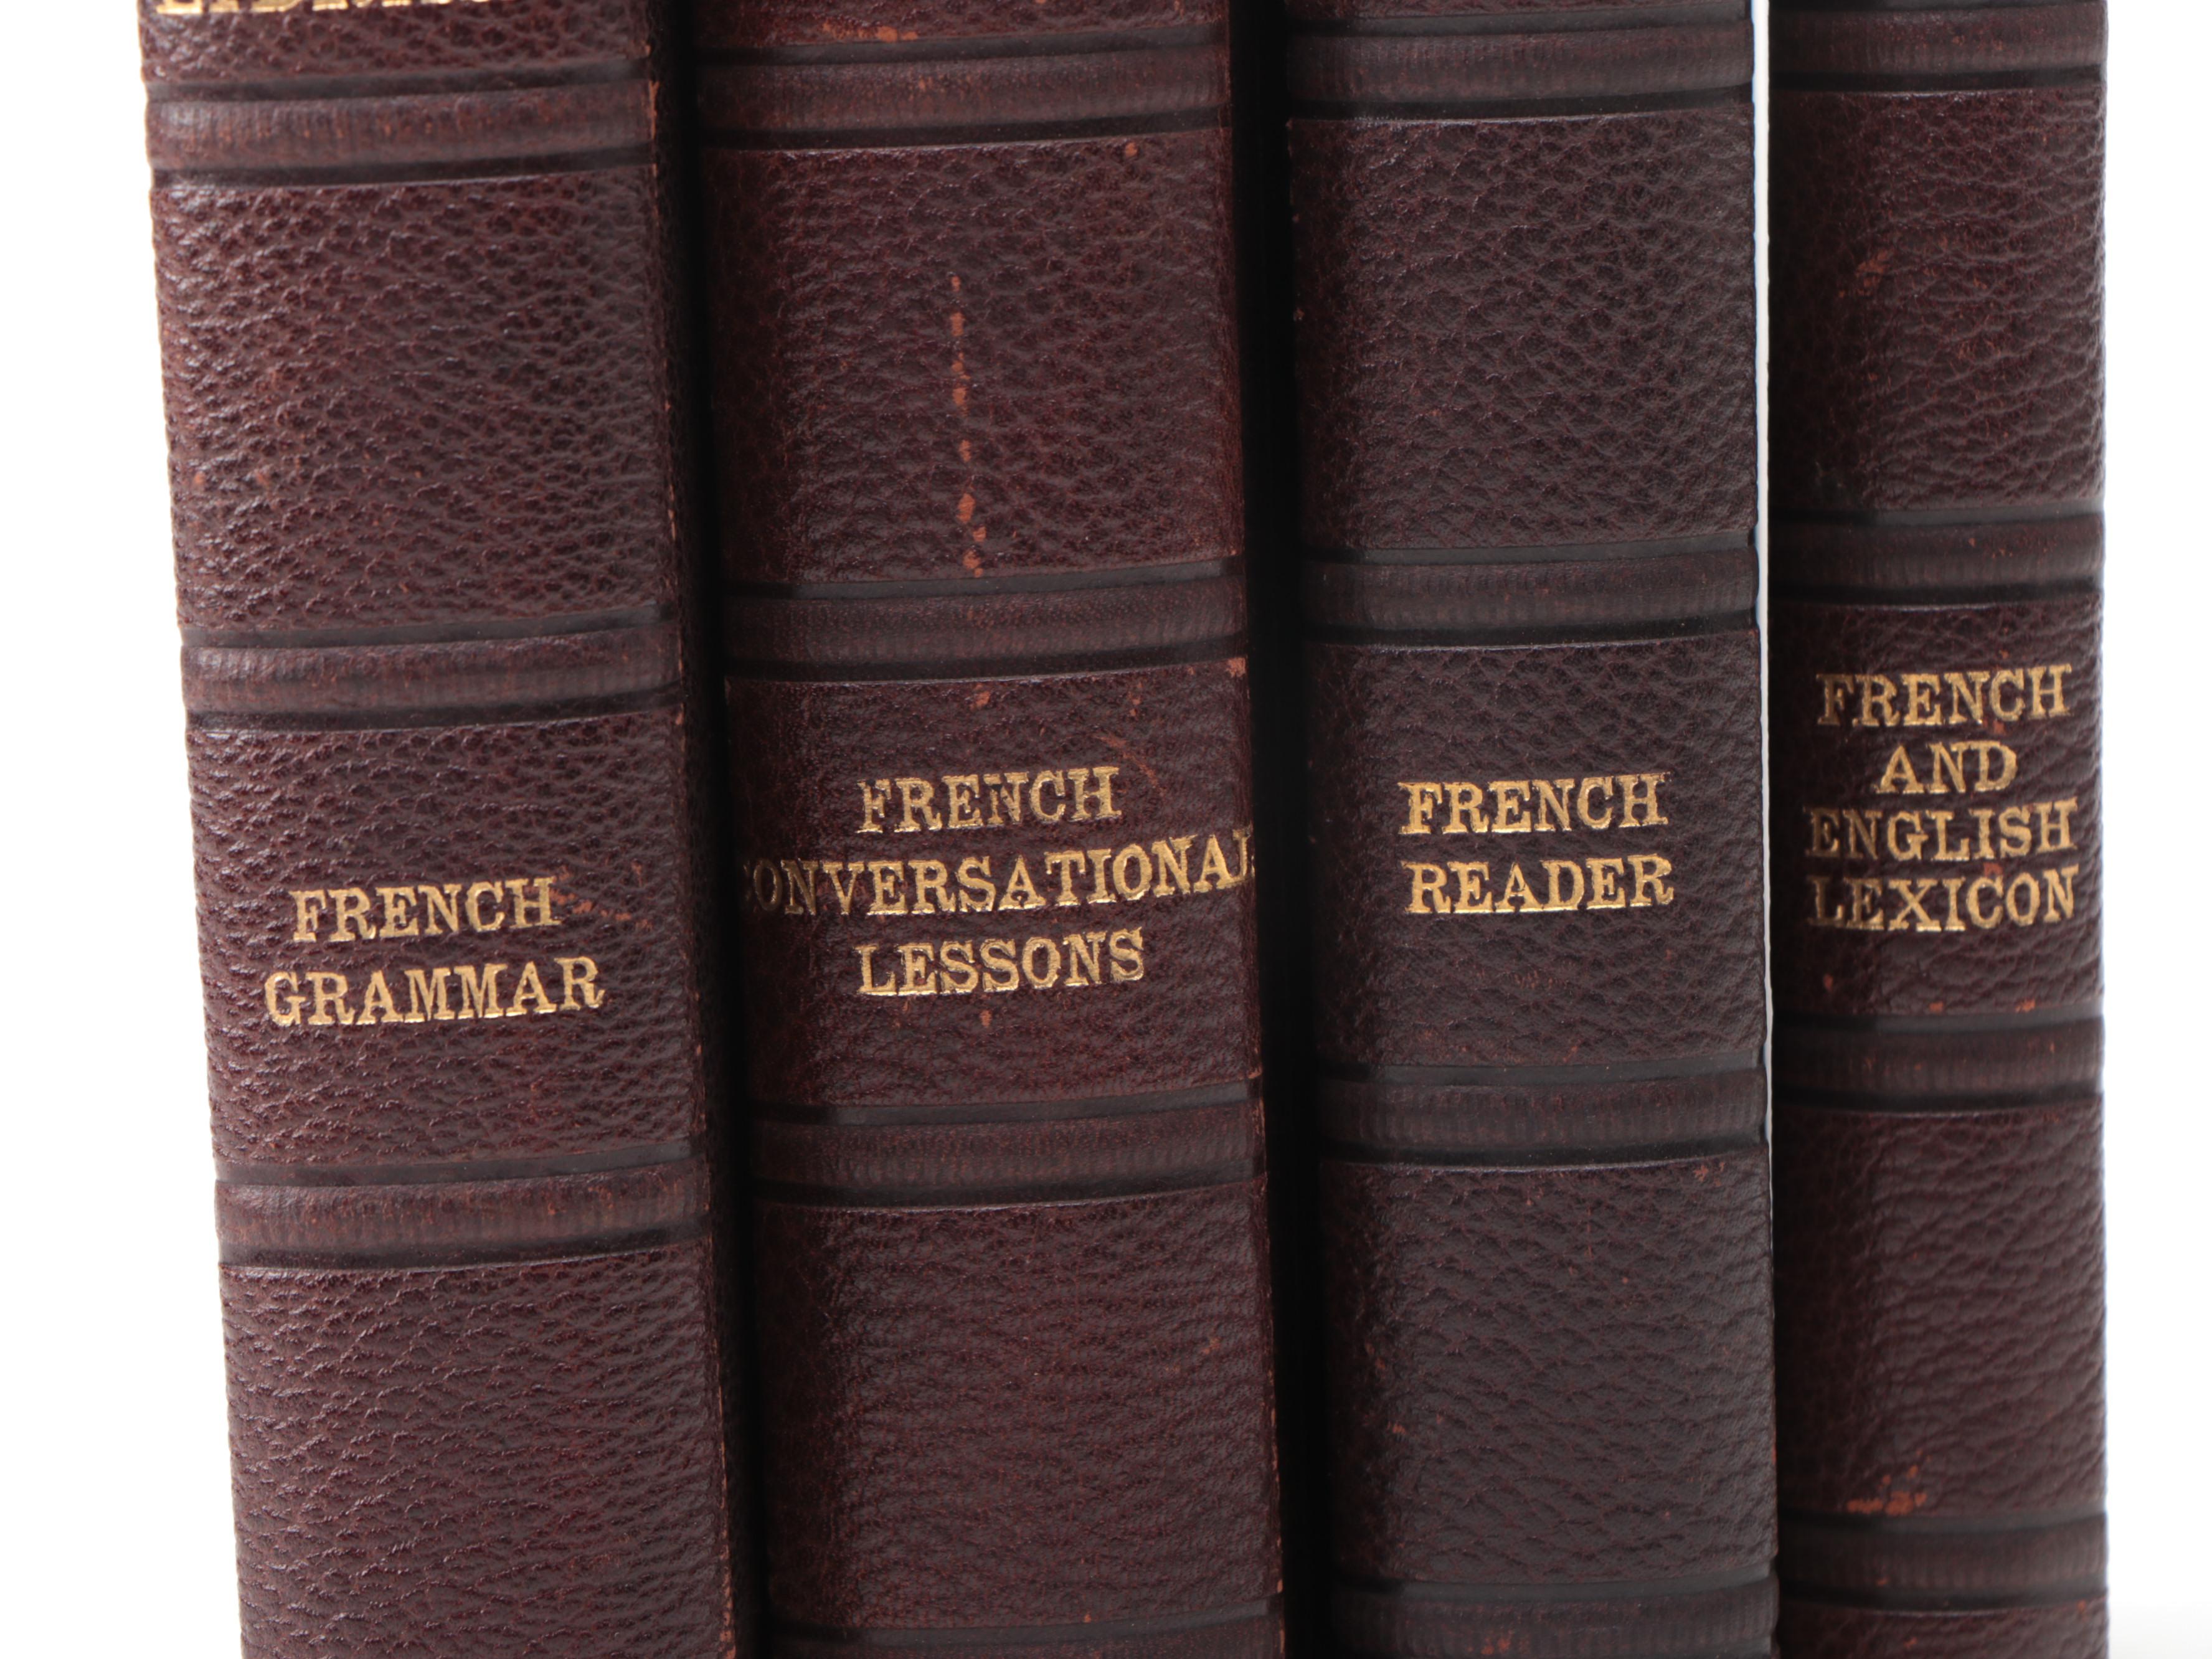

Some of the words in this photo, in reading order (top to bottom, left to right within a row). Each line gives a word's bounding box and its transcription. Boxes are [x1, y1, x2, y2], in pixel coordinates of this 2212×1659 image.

[1816, 663, 2073, 727] FRENCH
[857, 767, 1122, 833] FRENCH
[1874, 740, 2018, 795] AND
[1397, 772, 1670, 834] FRENCH
[1804, 796, 2077, 861] ENGLISH
[742, 825, 1255, 915] ONVERSATIONAL
[1401, 853, 1675, 914] READER
[1806, 864, 2079, 932] LEXICON
[289, 876, 561, 942] FRENCH
[264, 956, 605, 1026] GRAMMAR
[855, 926, 1145, 996] LESSONS
